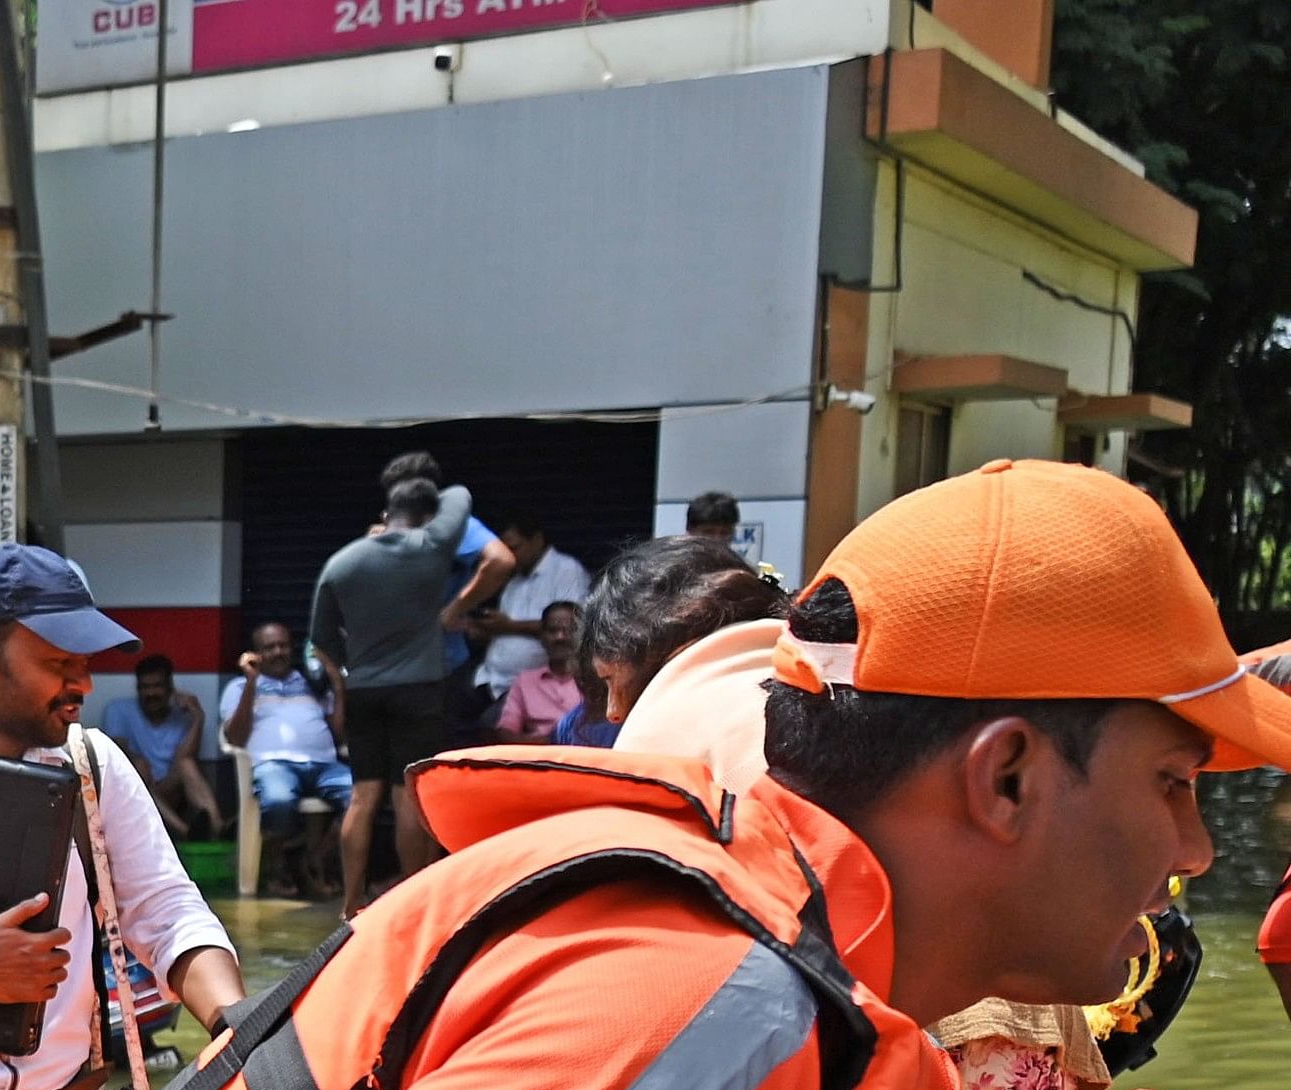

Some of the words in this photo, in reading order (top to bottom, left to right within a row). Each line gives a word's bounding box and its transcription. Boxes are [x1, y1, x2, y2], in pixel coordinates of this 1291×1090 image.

[91, 4, 155, 33] CUB
[334, 0, 381, 33] 24
[395, 0, 464, 24] Hrs
[0, 433, 14, 481] HOME
